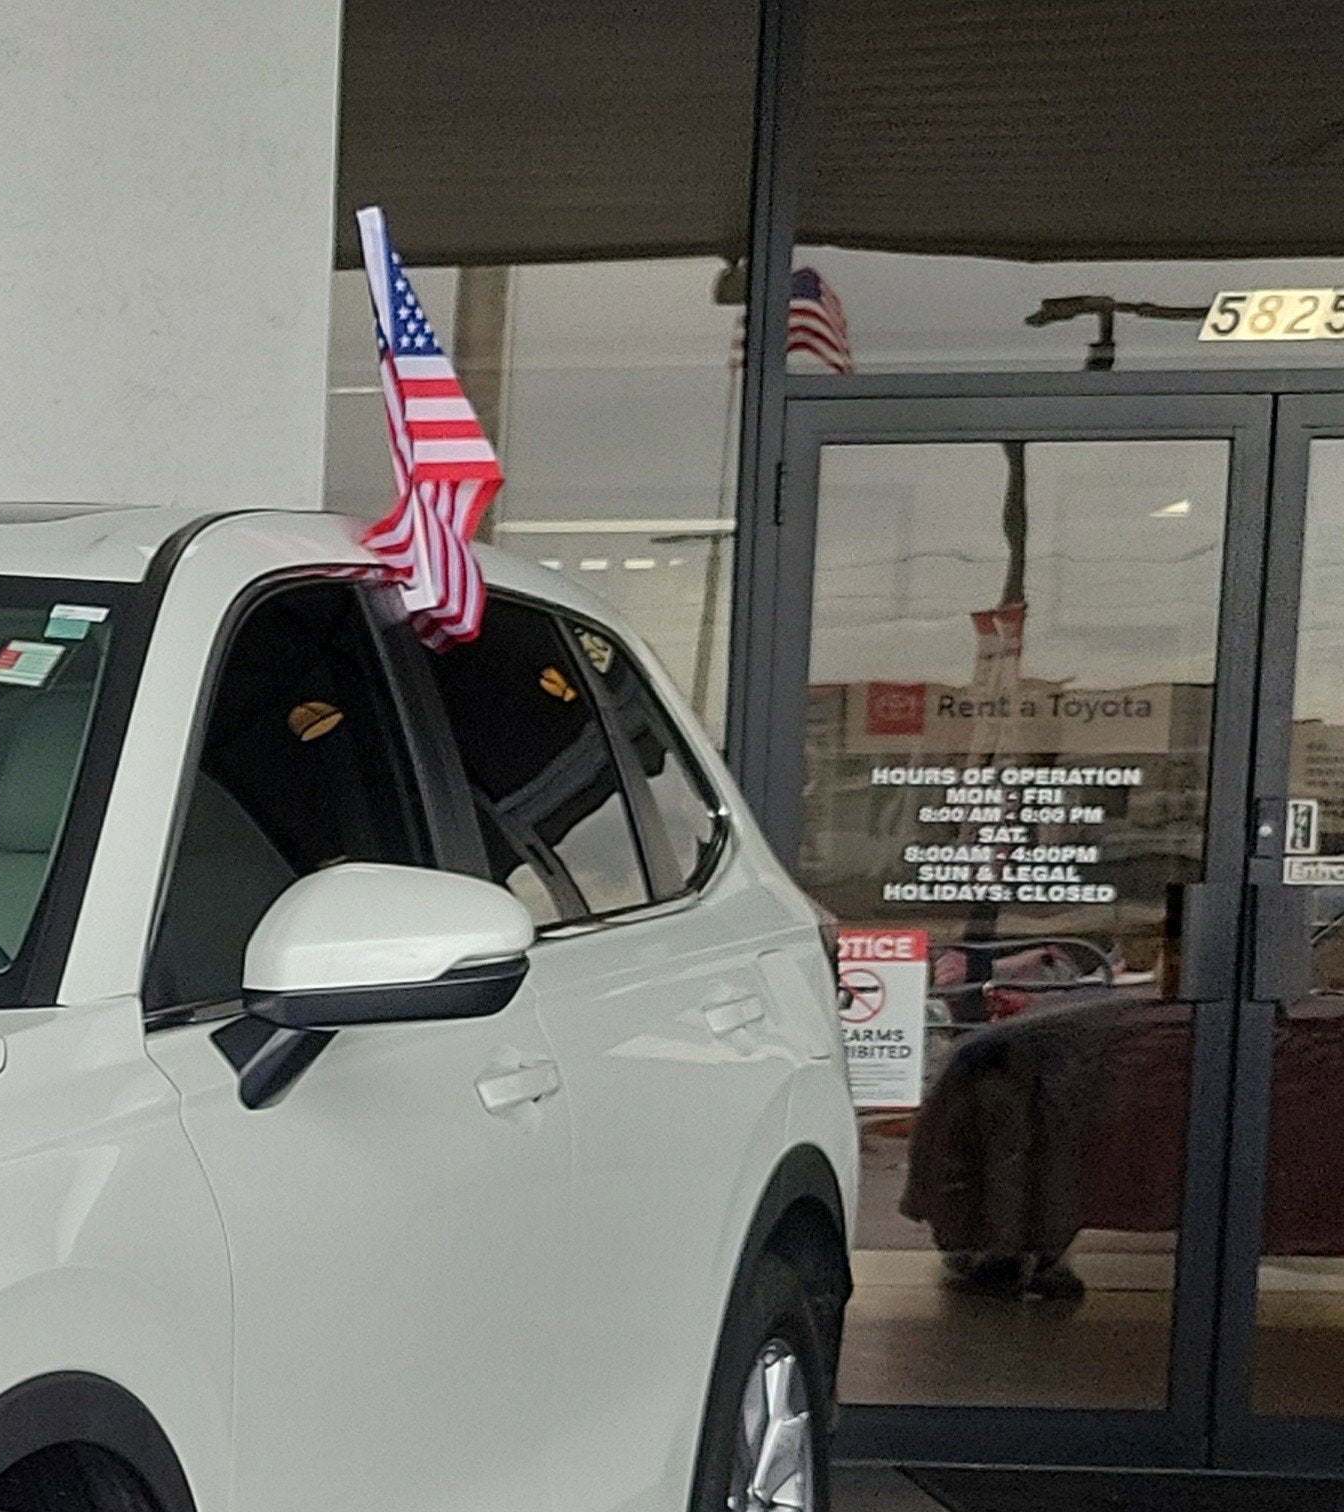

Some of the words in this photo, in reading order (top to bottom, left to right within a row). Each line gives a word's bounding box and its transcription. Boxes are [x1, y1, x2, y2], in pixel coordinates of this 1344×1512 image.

[1210, 294, 1344, 336] 5825
[937, 694, 1010, 718] Rent
[1020, 700, 1036, 718] a
[1048, 694, 1153, 723] Toyota
[871, 766, 957, 786] HOURS
[962, 766, 996, 786] OF
[1000, 767, 1142, 787] OPERATION
[946, 786, 1003, 805] MON
[1022, 787, 1064, 805] FRI
[967, 806, 1002, 823] AM
[1069, 806, 1105, 824] PM
[917, 865, 970, 882] SUN
[975, 865, 995, 882] &
[1002, 865, 1081, 883] LEGAL
[1015, 884, 1116, 903] CLOSED
[837, 935, 914, 959] OTICE
